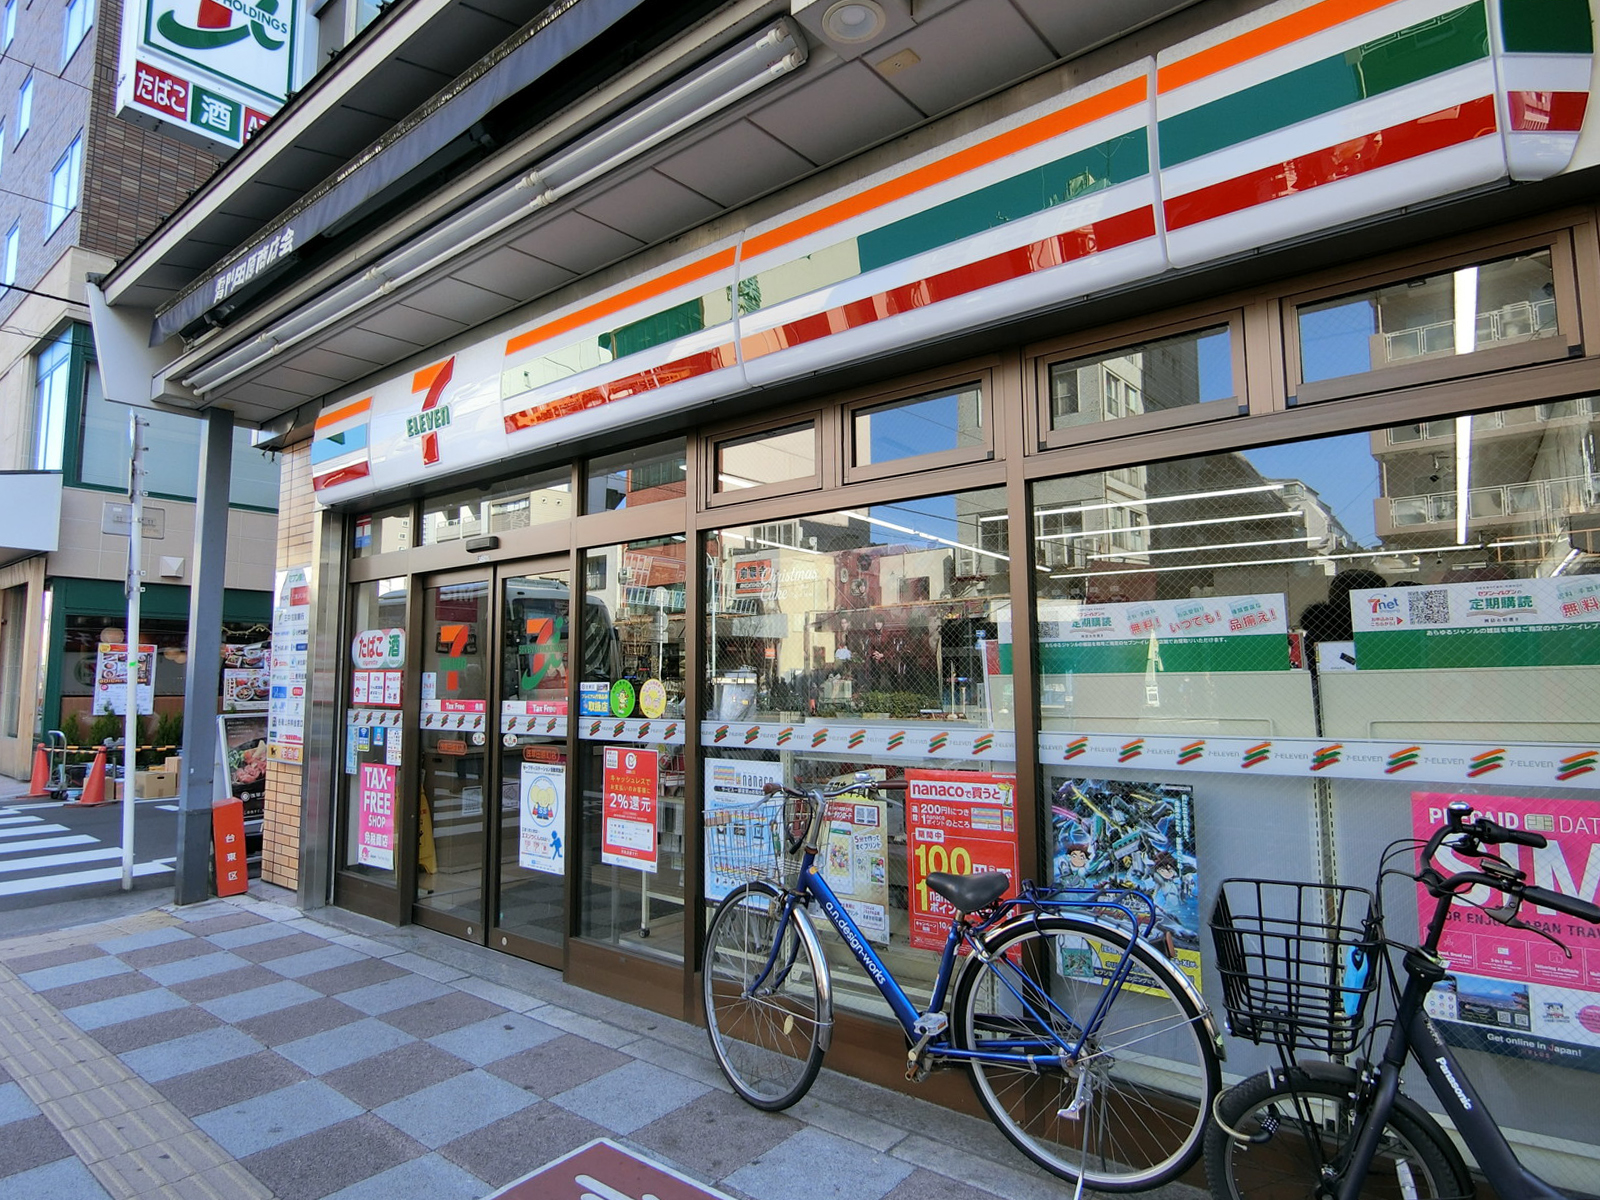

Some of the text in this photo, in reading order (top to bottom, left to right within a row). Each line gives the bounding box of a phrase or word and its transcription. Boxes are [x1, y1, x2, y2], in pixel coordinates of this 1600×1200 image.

[137, 69, 187, 113] たばこ
[201, 94, 233, 131] 酒
[411, 355, 456, 466] 7
[761, 567, 818, 584] Christmas
[760, 585, 788, 602] Cake
[1469, 595, 1533, 611] 定期購読
[1368, 598, 1399, 614] 7net
[1562, 596, 1600, 617] 無料
[1071, 616, 1113, 628] 定期購読
[1169, 609, 1222, 633] いつでも!
[1229, 607, 1278, 632] 品揃え!
[359, 634, 383, 658] たばこ
[388, 634, 400, 657] 酒
[445, 702, 454, 710] Tax
[532, 704, 557, 713] Tax Free
[364, 767, 392, 790] TAX-
[611, 774, 651, 786] キャッシュレスで
[363, 790, 391, 815] FREE
[610, 792, 651, 812] 2%還元
[912, 784, 1001, 799] nanacoで買うと
[368, 814, 386, 828] SHOP
[917, 829, 942, 840] 期間中
[225, 833, 238, 881] 台東区
[1433, 832, 1600, 916] SIM
[916, 878, 928, 911] 1
[930, 902, 957, 914] ポイン
[825, 901, 886, 985] a.n.design-works
[1487, 1033, 1582, 1057] Get online in Japan!
[1436, 1056, 1472, 1110] Panasonic
